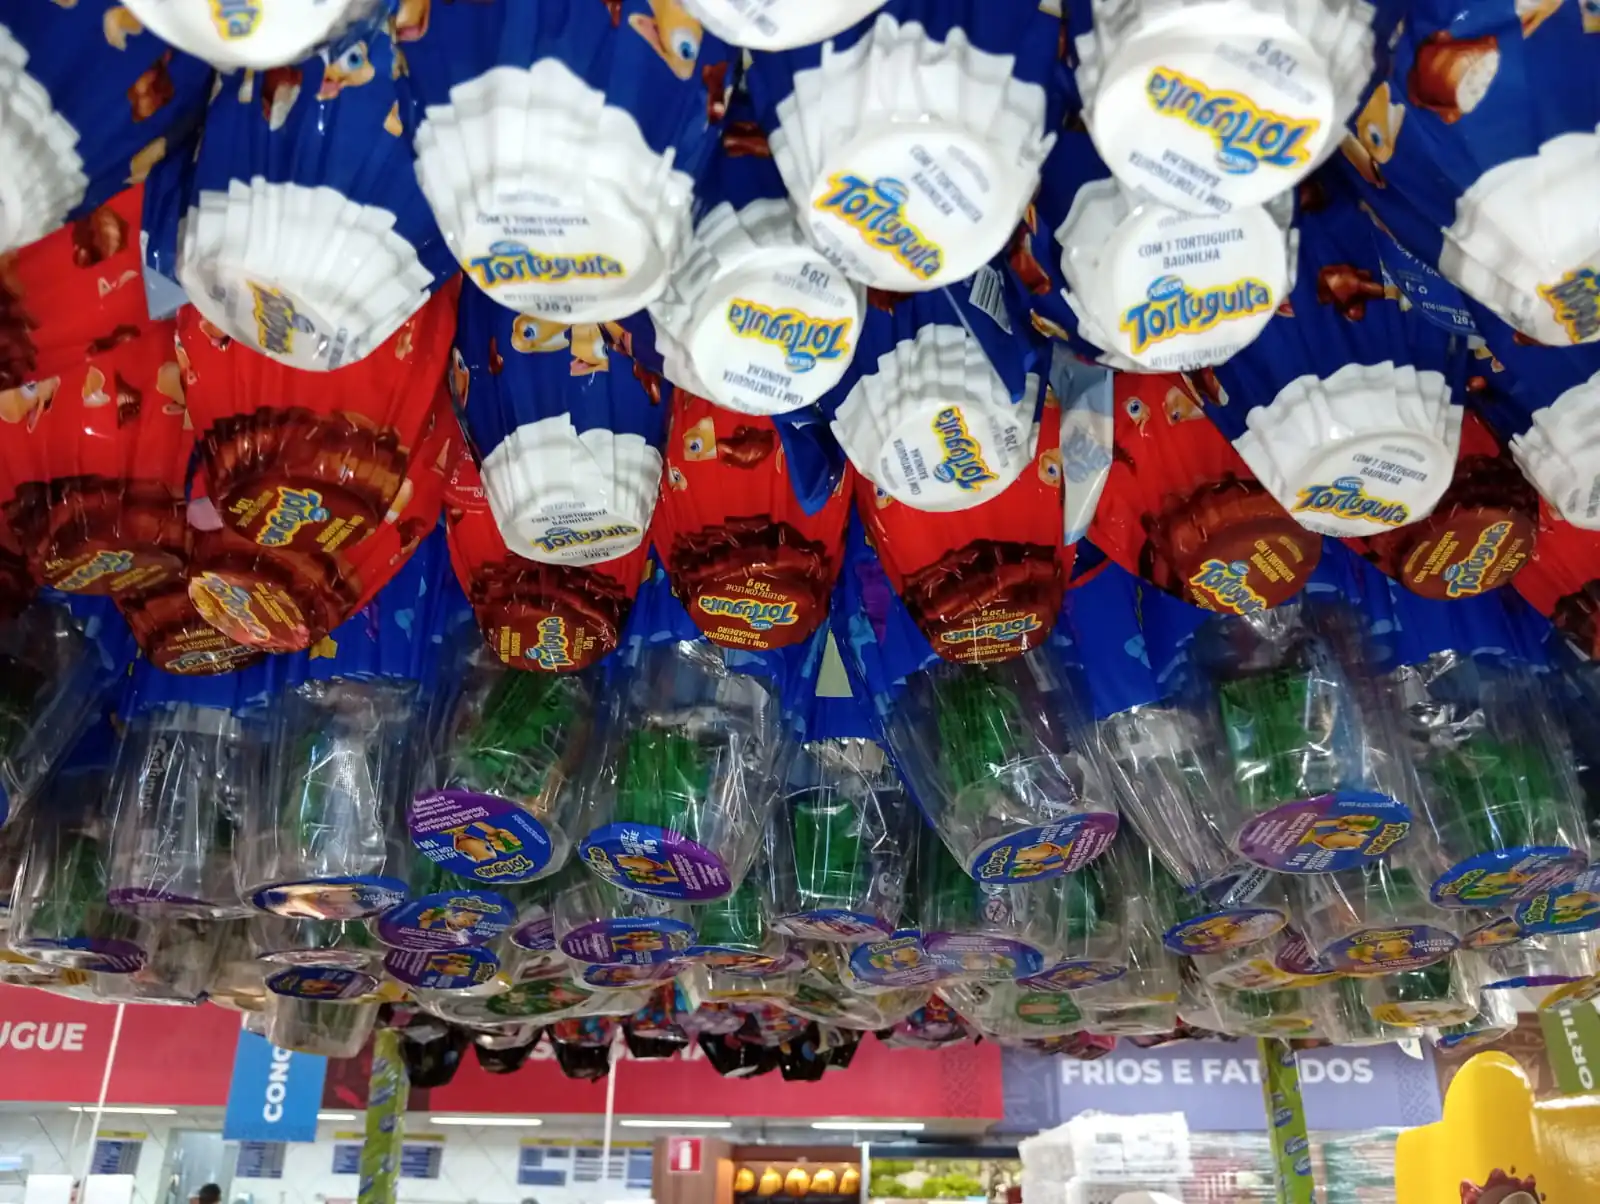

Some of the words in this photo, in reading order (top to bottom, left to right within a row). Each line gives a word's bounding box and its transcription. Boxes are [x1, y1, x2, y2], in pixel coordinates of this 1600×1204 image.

[1148, 73, 1306, 167] Tortuguita
[822, 174, 941, 277] Tortuguita
[1138, 243, 1163, 258] COM
[1175, 228, 1245, 251] TORTUGUITA
[469, 249, 623, 285] Tortuguita
[800, 262, 811, 277] g
[1162, 248, 1221, 269] BAUNILHA
[808, 270, 831, 288] 120
[536, 302, 561, 312] 120
[1125, 281, 1270, 347] Tortuguita
[728, 302, 848, 360] Tortuguita
[785, 389, 804, 406] COM
[935, 407, 995, 490] Tortuguita
[1299, 484, 1409, 523] Tortuguita
[534, 525, 638, 551] Tortuguita
[746, 578, 754, 588] g
[755, 581, 771, 591] 120
[700, 597, 793, 623] Tortuguita
[703, 630, 747, 645] TORTUGUITA
[717, 626, 761, 638] BRIGADEIRO
[943, 616, 1036, 640] Tortuguita
[538, 617, 569, 668] Tortuguita
[753, 639, 769, 649] COM
[1061, 1058, 1163, 1084] FRIOS
[1173, 1058, 1194, 1084] E
[1201, 1058, 1374, 1084] FATDOS
